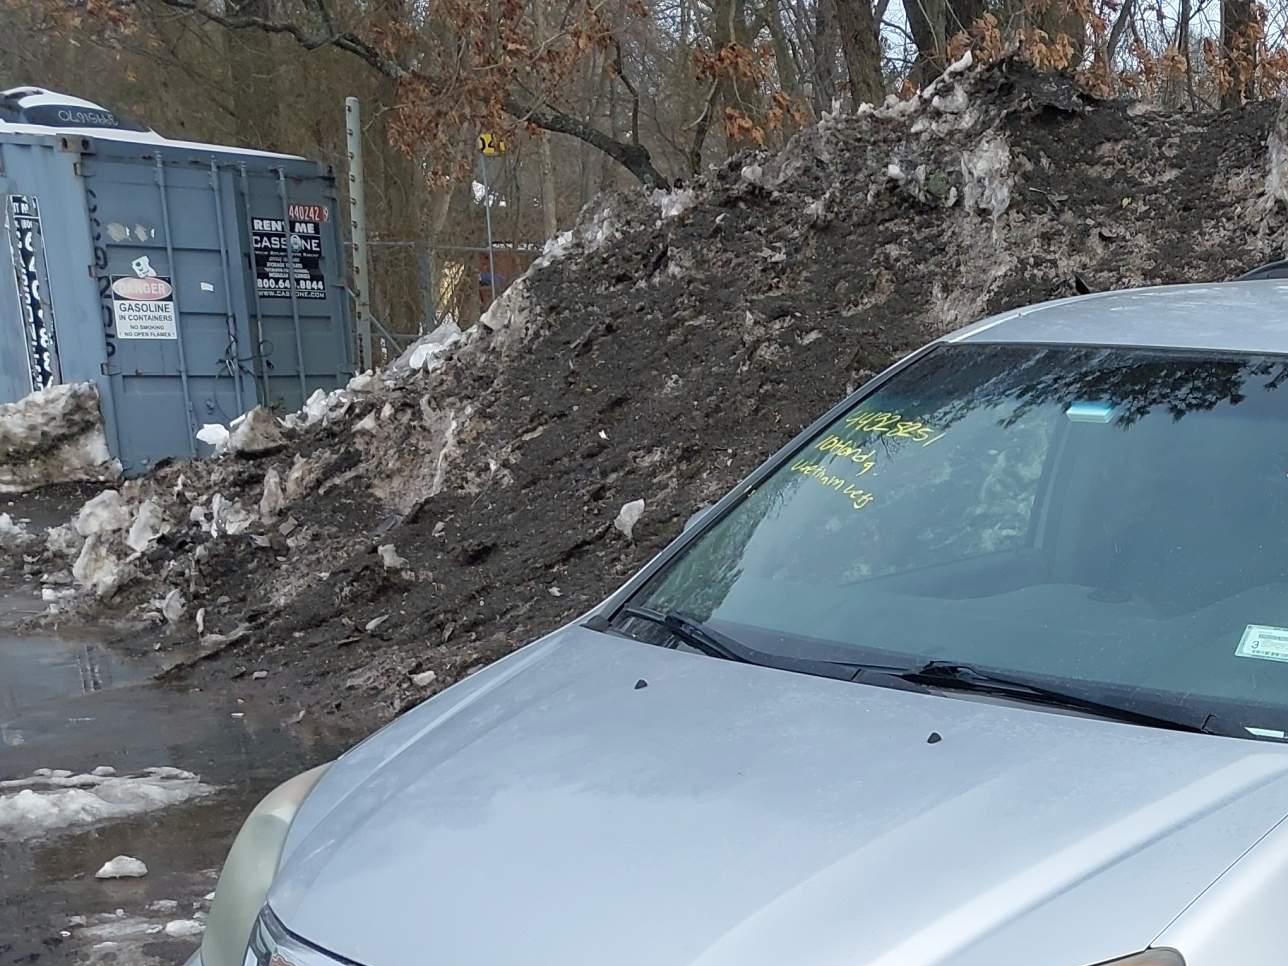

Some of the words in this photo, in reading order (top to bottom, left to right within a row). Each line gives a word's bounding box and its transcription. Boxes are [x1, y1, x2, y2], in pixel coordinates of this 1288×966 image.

[253, 219, 285, 231] REN
[294, 222, 315, 234] ME
[257, 279, 323, 290] 800.64.8844
[119, 303, 171, 312] GASOLINE
[128, 314, 173, 322] CONTAINERS
[1250, 640, 1260, 650] 3
